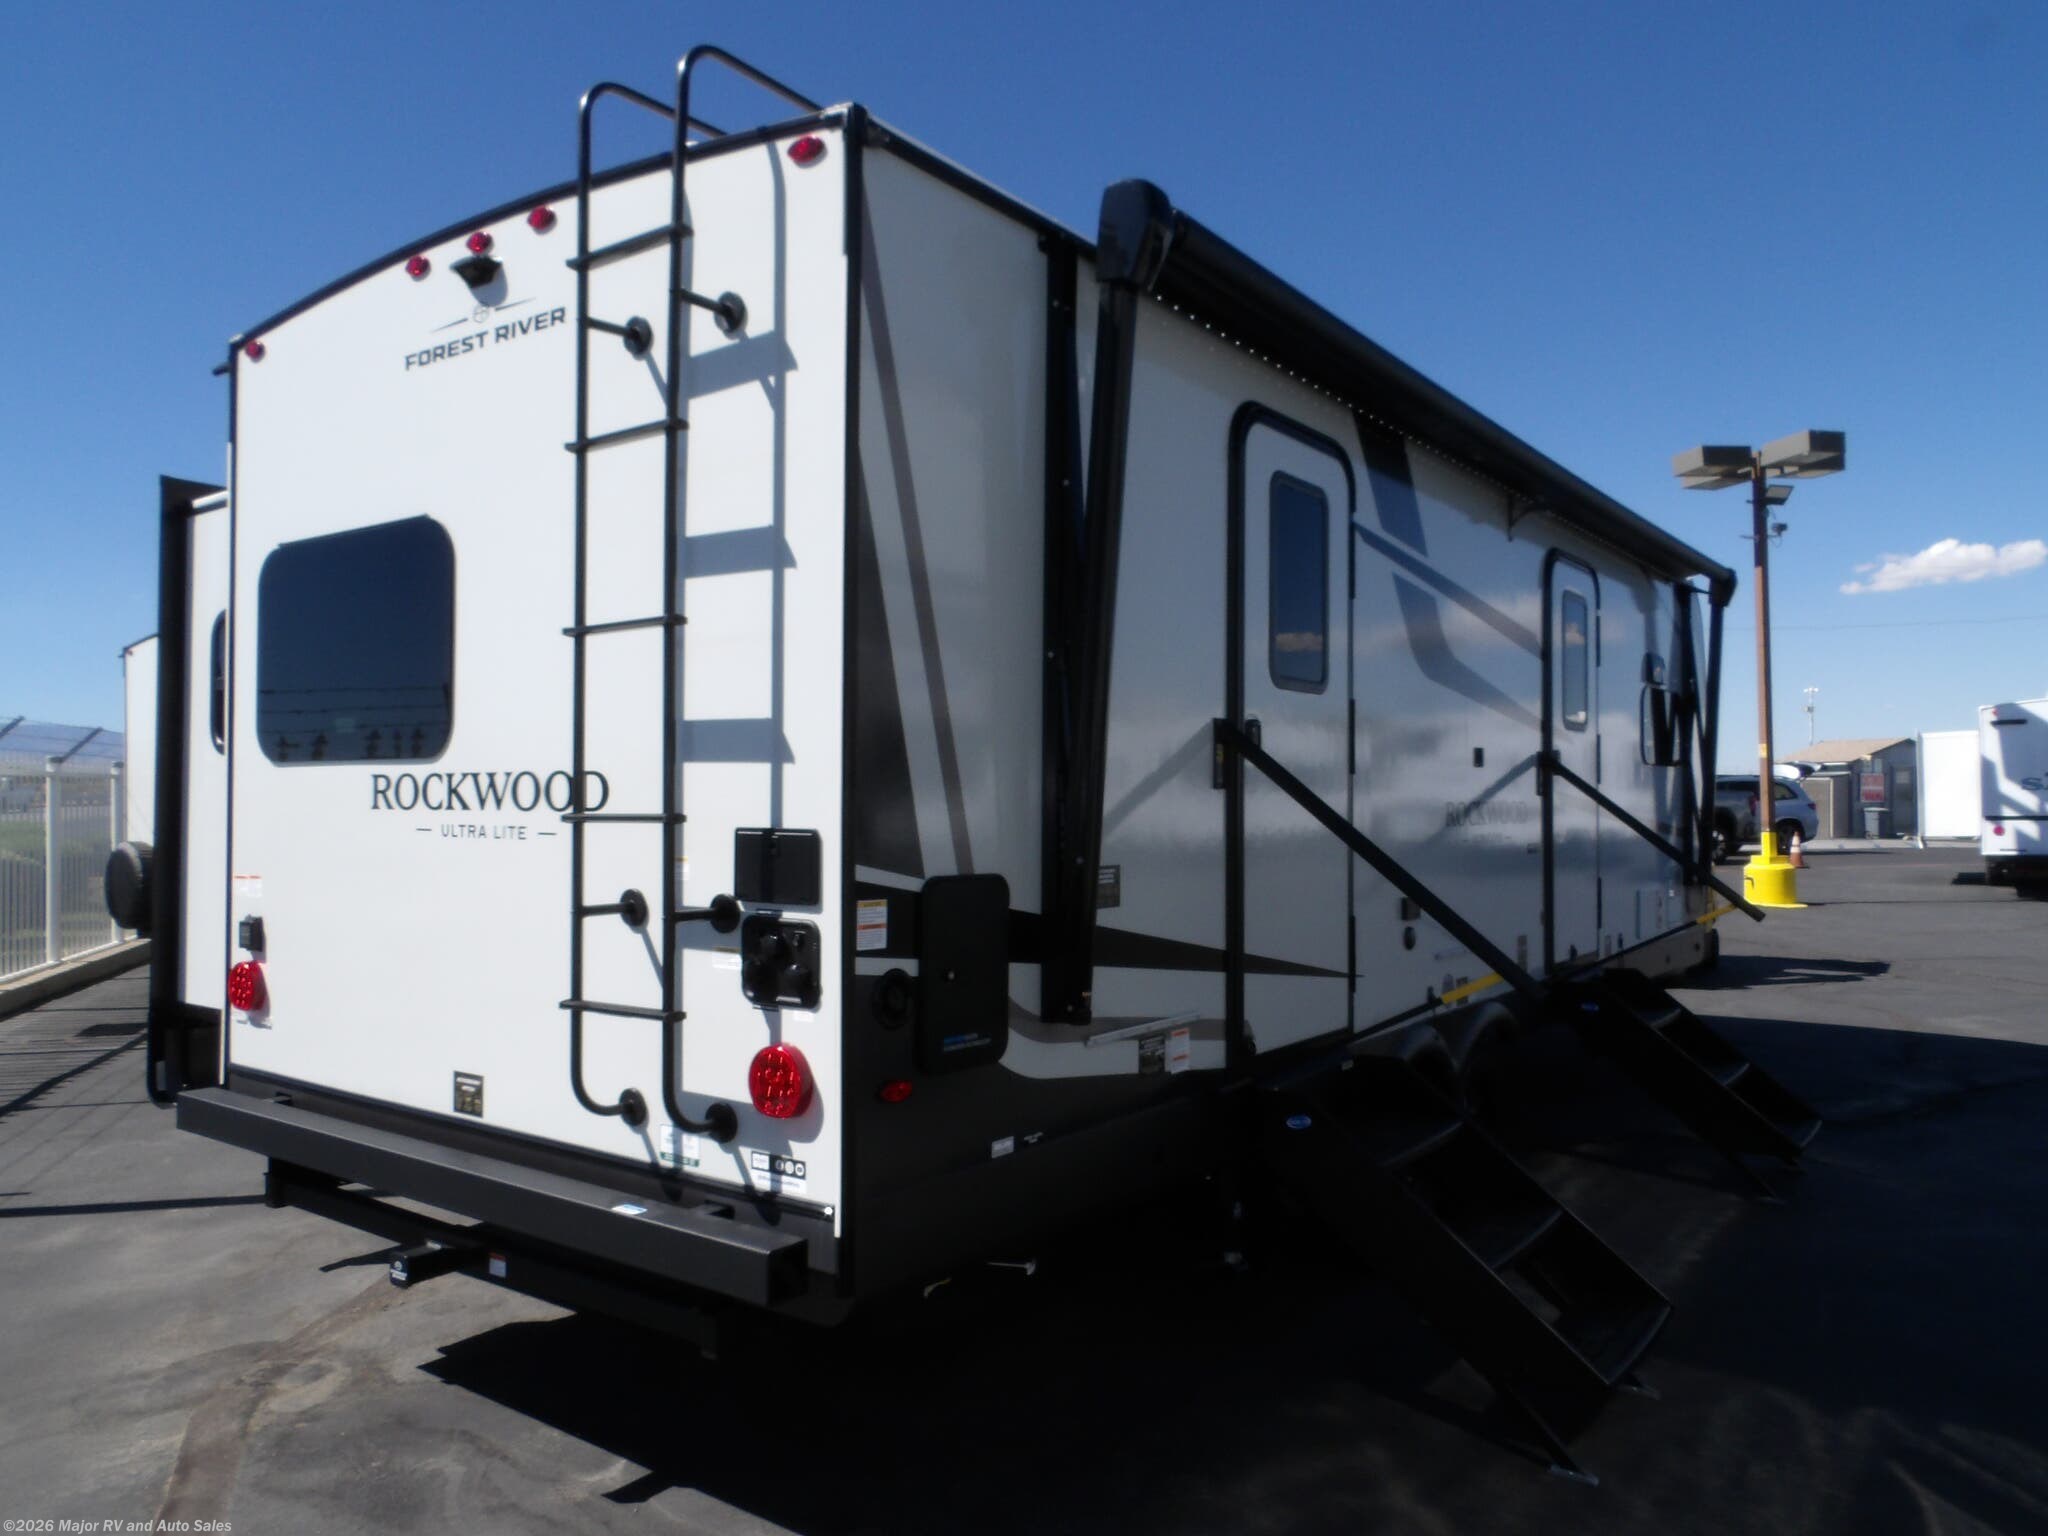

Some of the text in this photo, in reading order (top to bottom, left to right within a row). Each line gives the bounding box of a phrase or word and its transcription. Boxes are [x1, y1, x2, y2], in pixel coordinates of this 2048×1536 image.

[404, 306, 566, 371] FOREST RIVER
[371, 770, 610, 813] ROCKWOOD
[441, 824, 527, 841] ULTRA LITE
